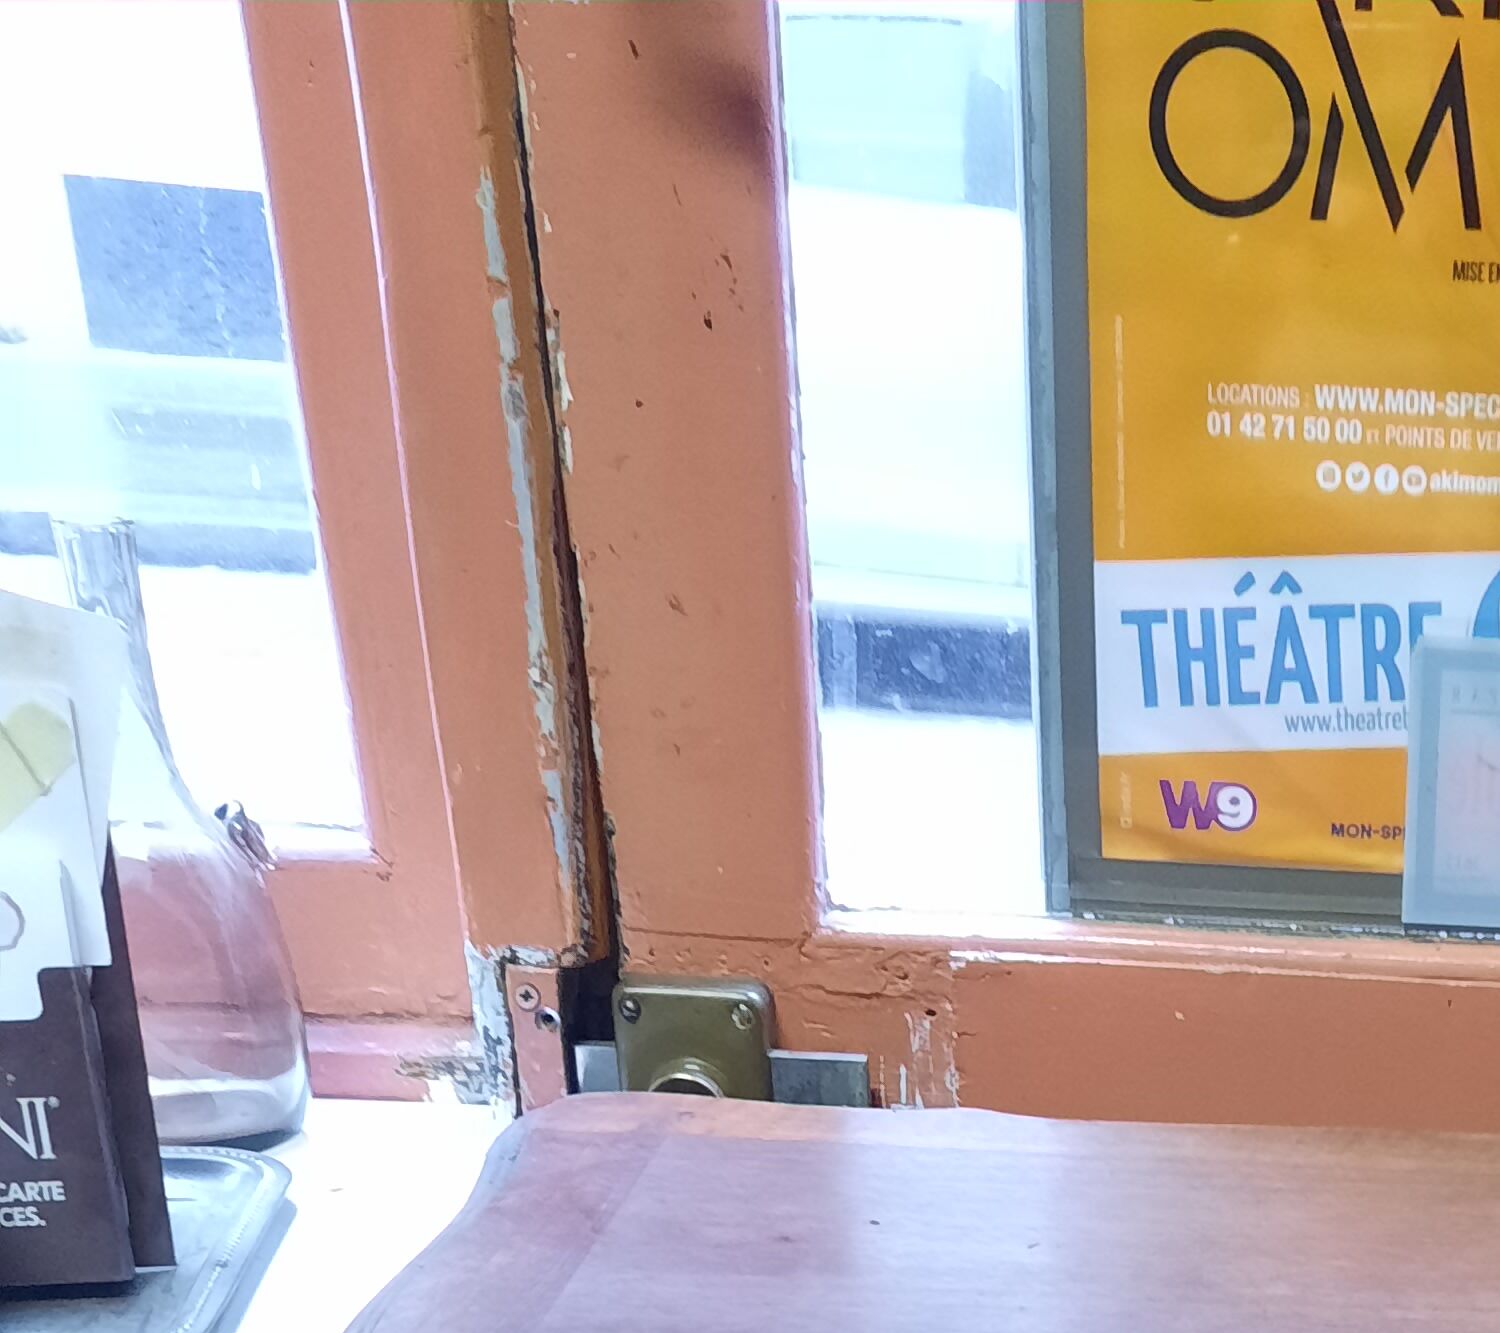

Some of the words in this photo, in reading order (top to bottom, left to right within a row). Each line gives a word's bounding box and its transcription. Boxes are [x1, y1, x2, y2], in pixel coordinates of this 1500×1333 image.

[1452, 259, 1485, 283] MISE
[1207, 382, 1300, 409] LOCATIONS
[1206, 409, 1231, 438] 01
[1239, 412, 1266, 440] 42
[1271, 414, 1296, 441] 71
[1303, 415, 1331, 444] 50
[1335, 417, 1363, 445] 00
[1385, 423, 1445, 449] POINTS
[1450, 427, 1472, 450] DE
[1159, 779, 1257, 831] W9
